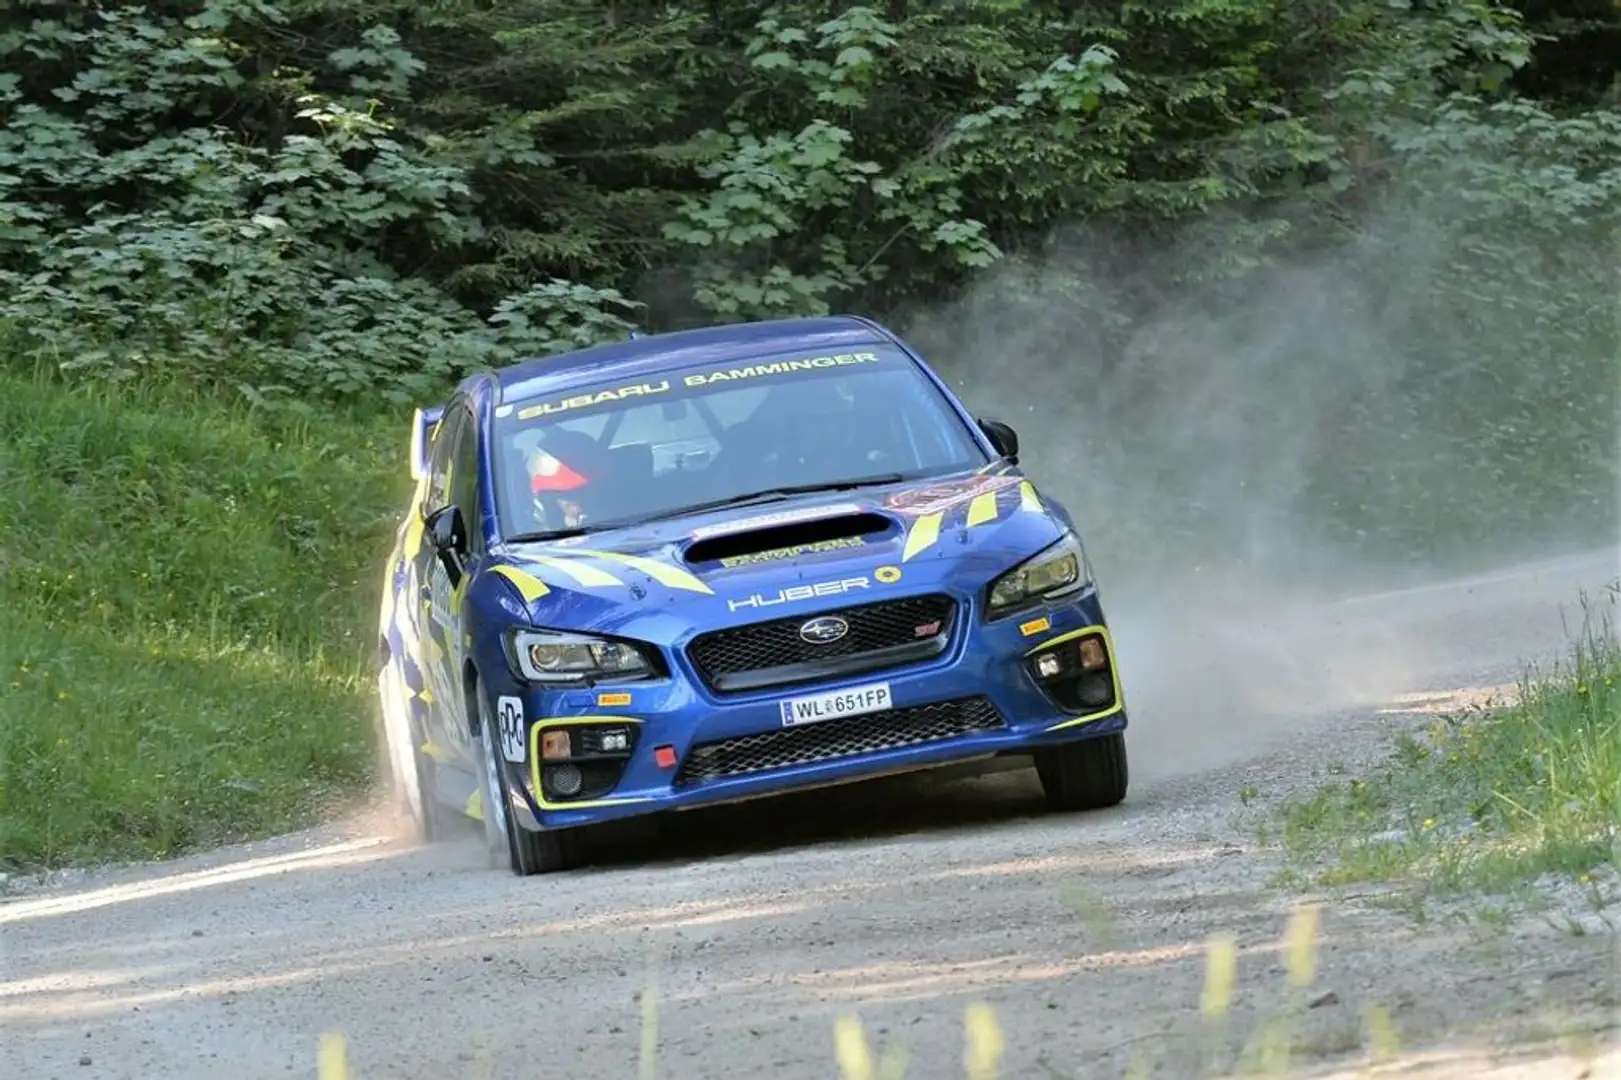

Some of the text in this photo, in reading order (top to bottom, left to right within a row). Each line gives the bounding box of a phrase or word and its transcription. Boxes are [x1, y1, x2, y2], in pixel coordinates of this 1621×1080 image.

[517, 351, 880, 420] SUBARU BAMMINGER
[727, 576, 871, 612] HUBER
[796, 688, 887, 718] WL 651FP
